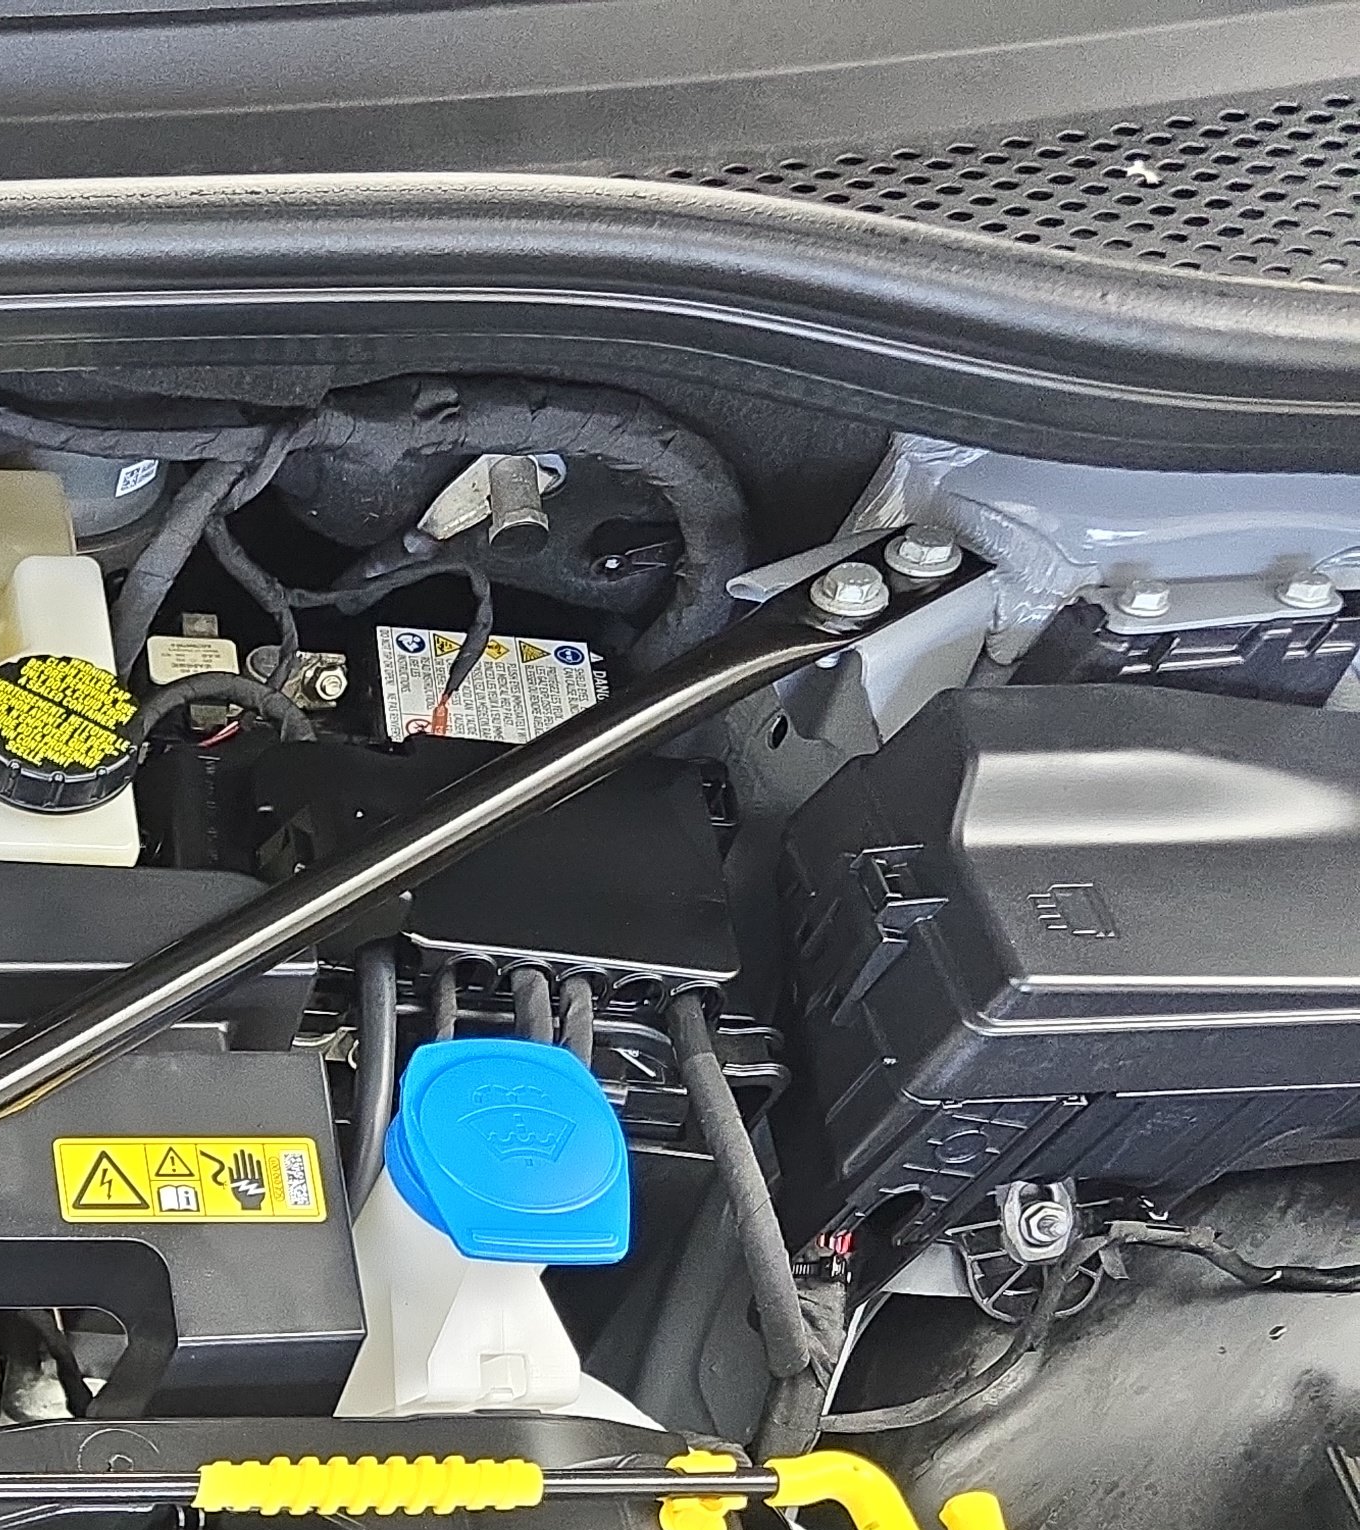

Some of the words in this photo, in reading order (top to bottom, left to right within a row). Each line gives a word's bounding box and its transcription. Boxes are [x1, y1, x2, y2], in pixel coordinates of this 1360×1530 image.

[44, 657, 78, 676] CLEAN
[75, 671, 110, 692] FILLER
[109, 687, 131, 700] CAP
[419, 656, 431, 672] READ
[494, 661, 506, 672] GET
[17, 675, 27, 685] A
[26, 679, 63, 701] SEALED
[20, 665, 47, 682] ONLY
[72, 690, 102, 709] FLUID
[98, 704, 130, 724] FROM
[25, 658, 66, 681] BEFORE
[115, 700, 137, 716] USE
[496, 673, 509, 696] MEDICAL
[592, 670, 610, 701] DANG
[499, 697, 511, 711] HELP
[27, 707, 62, 727] AVANT
[59, 722, 75, 734] DE
[73, 729, 89, 741] LE
[65, 714, 116, 743] NETTOYER
[114, 738, 130, 751] LE
[12, 734, 73, 766] CONTENANT
[39, 736, 99, 767] PROVENANT
[67, 737, 90, 753] QUE
[87, 747, 104, 760] DU
